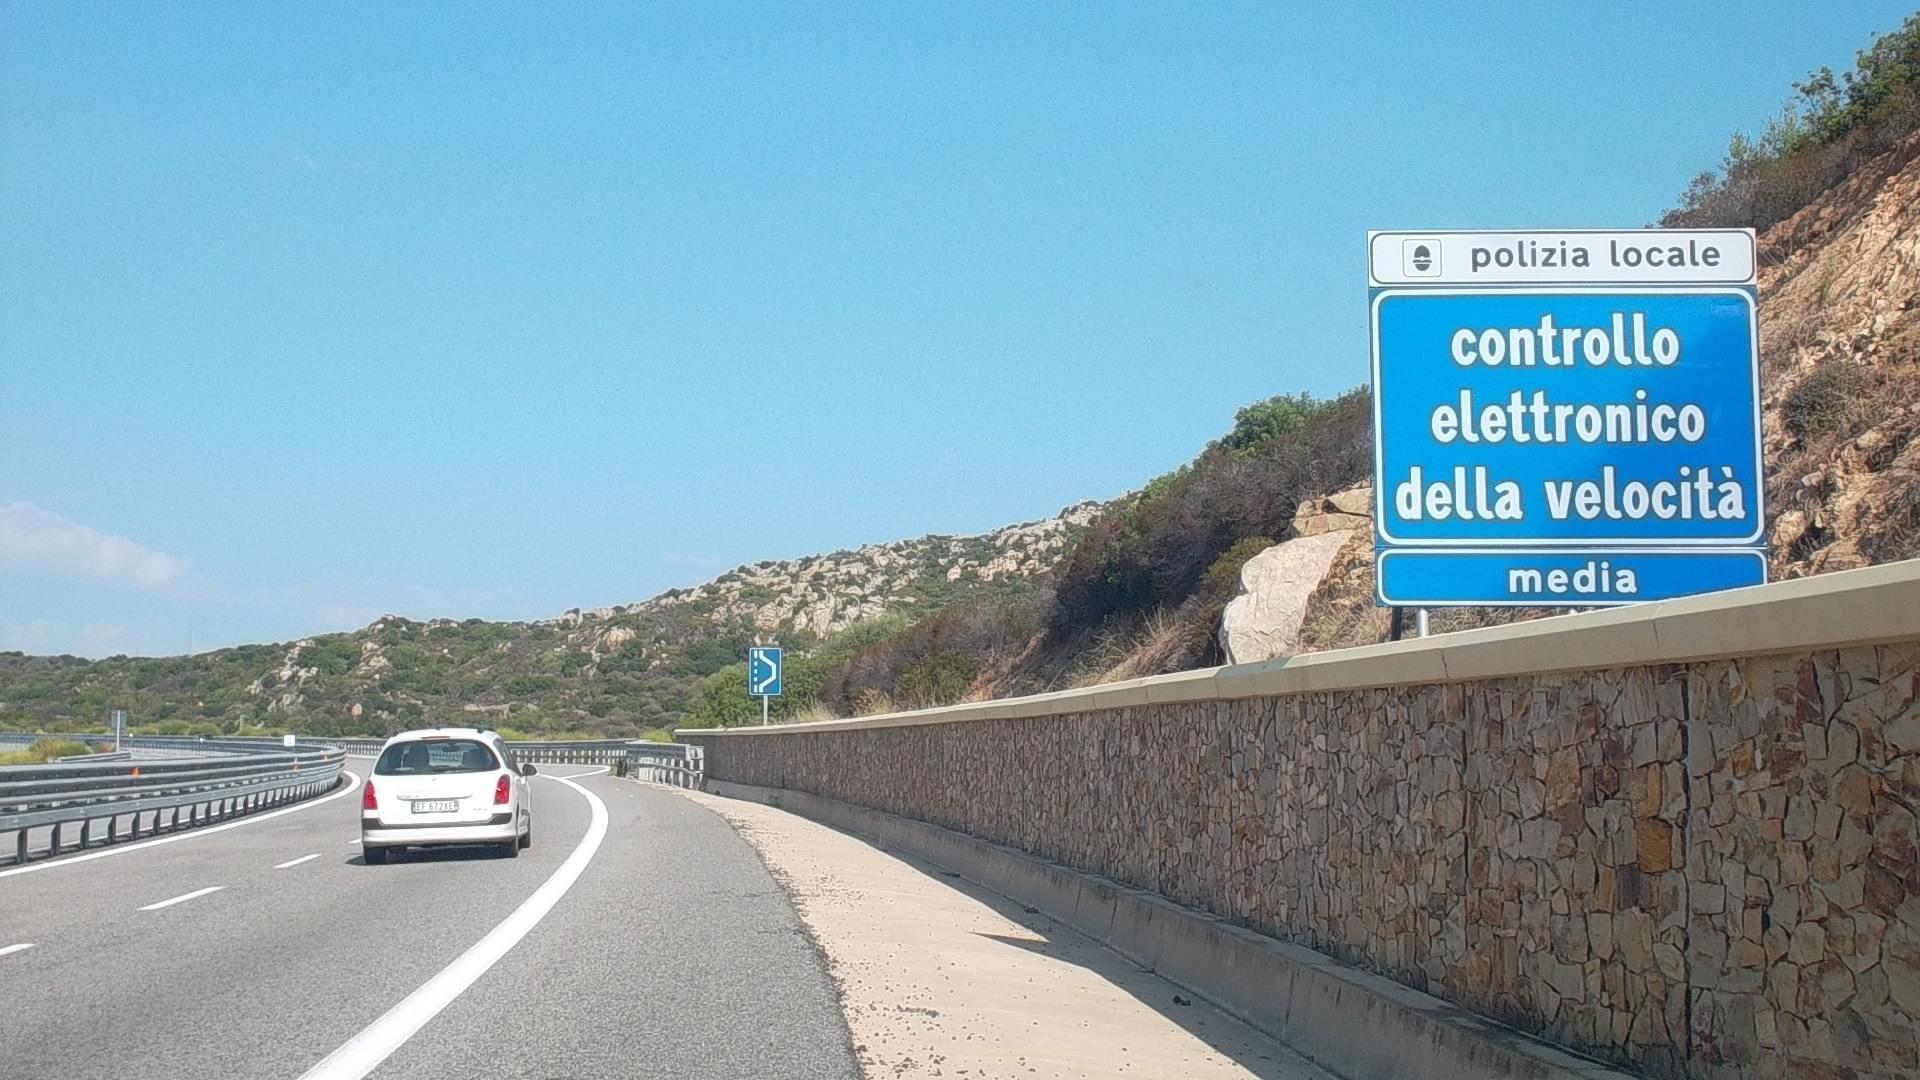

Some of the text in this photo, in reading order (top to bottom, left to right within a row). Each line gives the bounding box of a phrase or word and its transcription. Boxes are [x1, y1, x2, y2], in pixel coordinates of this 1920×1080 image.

[1471, 239, 1721, 273] polizia locale
[1451, 312, 1679, 366] controllo
[1431, 389, 1705, 443] elettronico
[1395, 466, 1746, 520] della velocità
[1509, 561, 1637, 593] media
